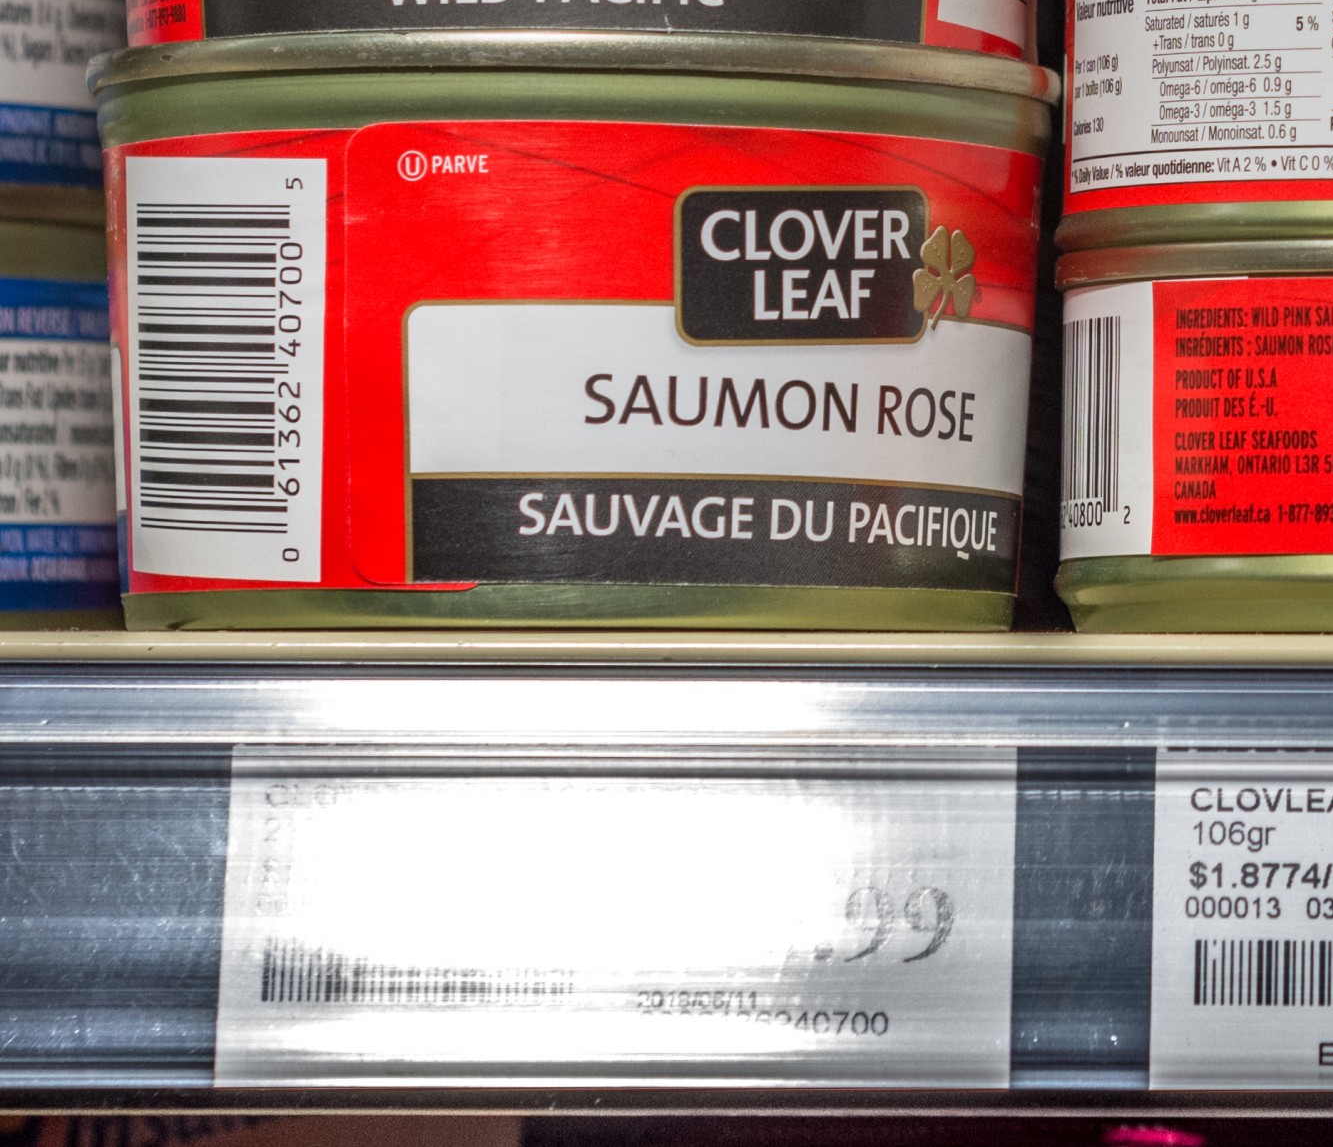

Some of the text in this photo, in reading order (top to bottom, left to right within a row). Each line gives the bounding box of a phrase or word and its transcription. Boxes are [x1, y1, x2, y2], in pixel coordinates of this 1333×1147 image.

[700, 208, 911, 261] CLOVER
[280, 242, 304, 359] 40700
[753, 270, 875, 321] LEAF
[1176, 369, 1224, 390] PRODUCT
[1227, 369, 1241, 387] OF
[584, 374, 976, 442] SAUMON ROSE
[1175, 430, 1317, 451] CLOVER LEAF SEAFOODS
[1175, 480, 1216, 500] CANADA
[519, 493, 997, 560] SAUVAGE DU PACIFIQUE
[1175, 504, 1270, 524] www.cloverleaf.ca
[1193, 821, 1276, 852] 106gr
[1185, 897, 1281, 919] 000013
